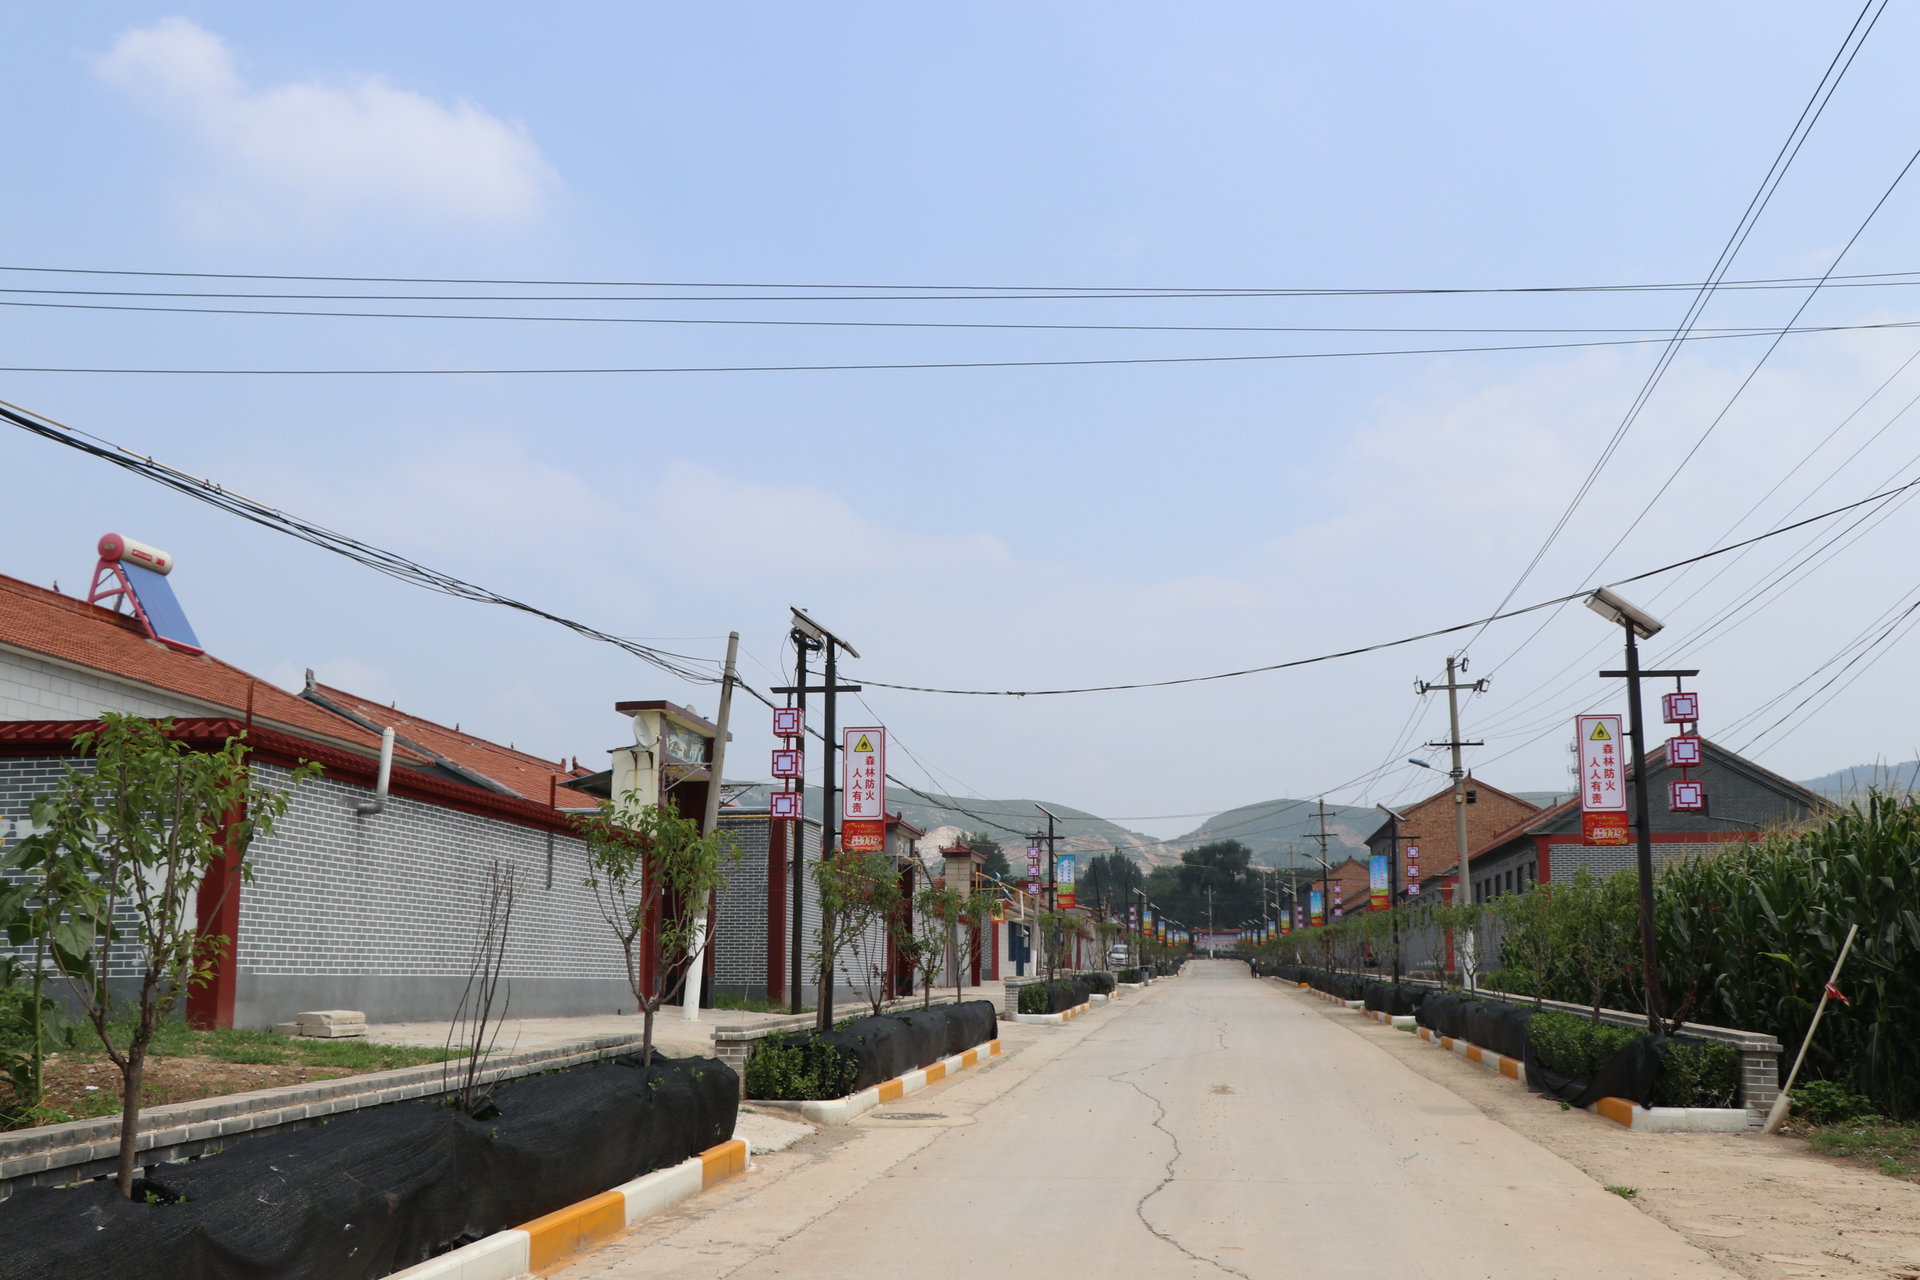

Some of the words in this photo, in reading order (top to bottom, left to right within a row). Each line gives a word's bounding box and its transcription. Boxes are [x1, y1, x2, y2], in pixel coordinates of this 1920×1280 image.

[865, 755, 875, 800] 森林防火
[1590, 757, 1602, 804] 人人有责
[1602, 744, 1616, 791] 森林防火
[852, 768, 862, 813] 人人有责
[862, 835, 879, 845] 119
[1604, 828, 1623, 837] 119
